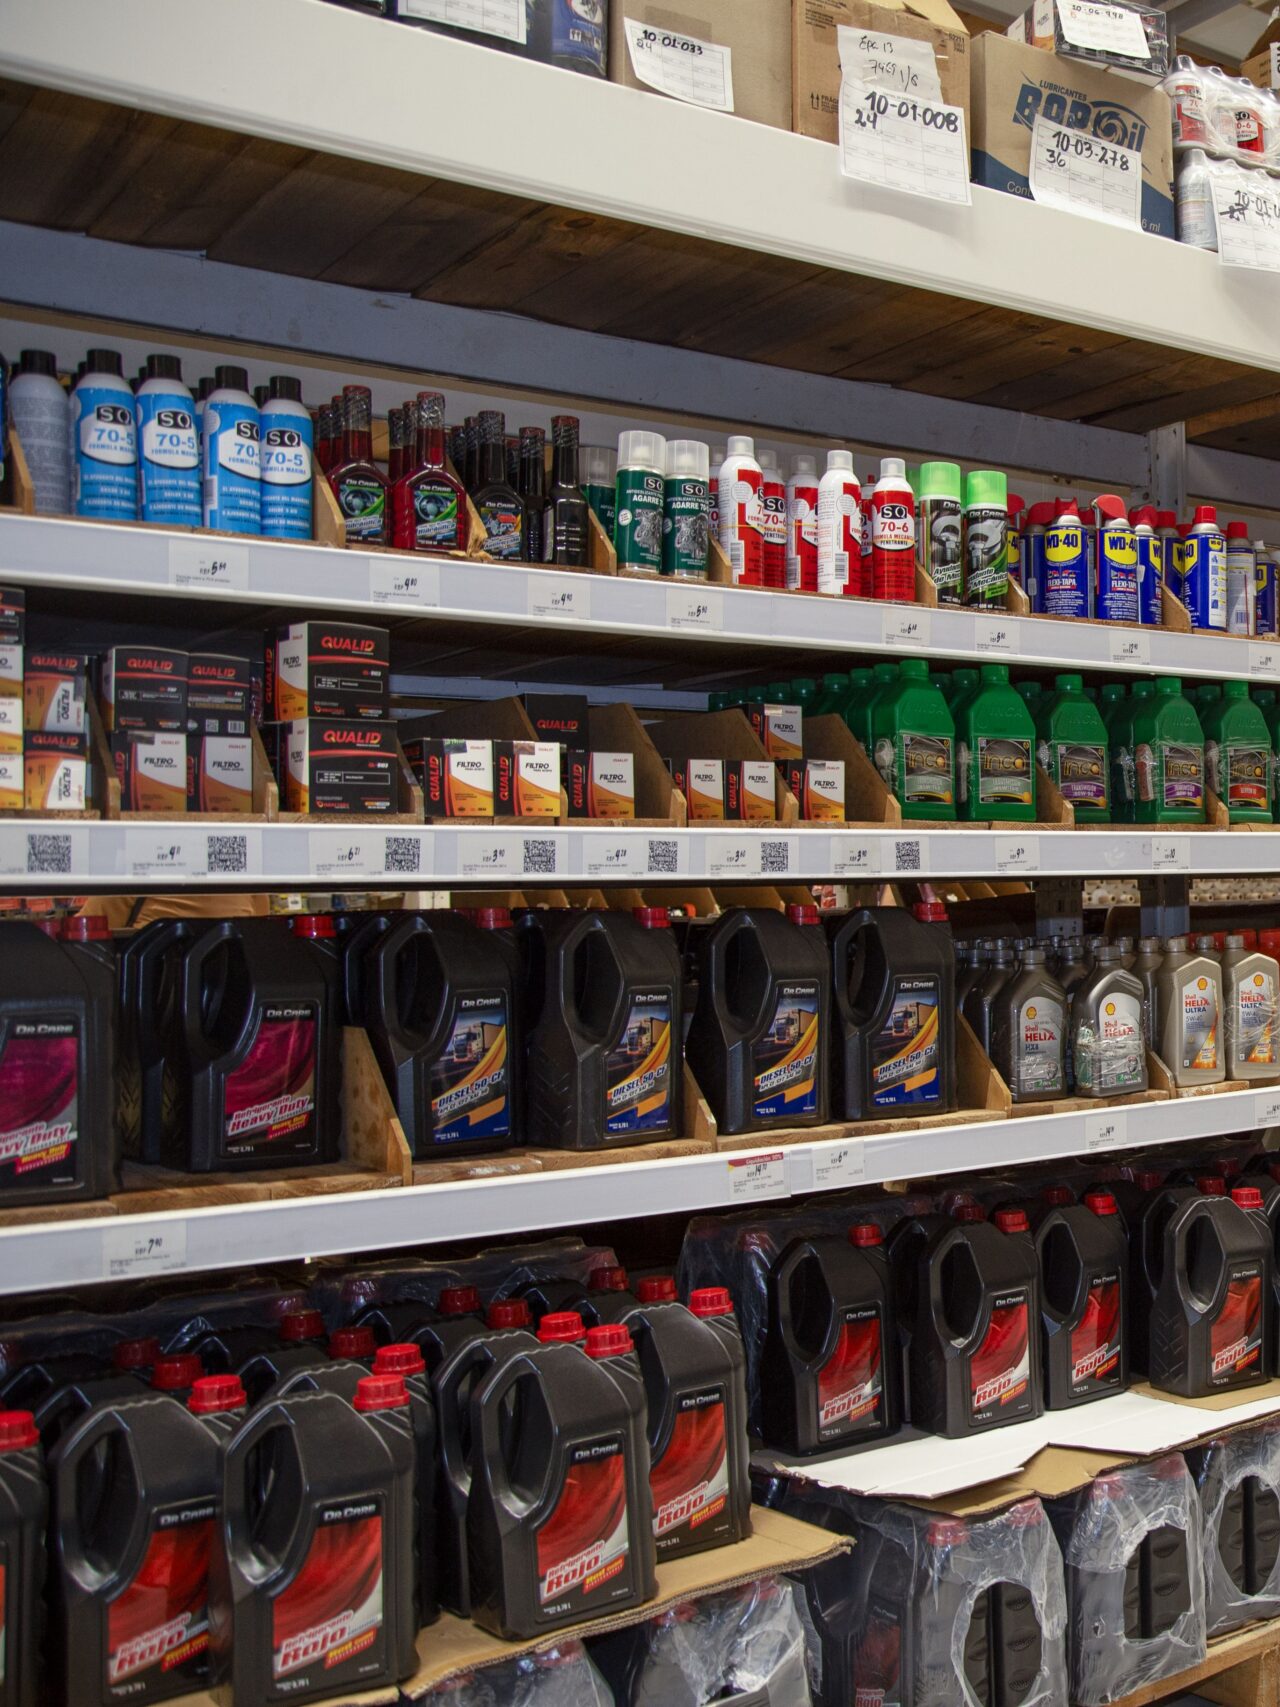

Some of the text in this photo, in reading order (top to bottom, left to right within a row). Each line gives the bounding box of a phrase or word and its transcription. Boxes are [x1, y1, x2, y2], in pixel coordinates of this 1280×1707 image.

[1039, 79, 1088, 102] LUBRICANTES
[855, 108, 878, 130] 24
[864, 91, 959, 134] 10-01-008
[1052, 130, 1129, 171] 10-03-278
[99, 406, 131, 425] SQ
[160, 411, 192, 429] SQ
[94, 428, 134, 446] 70-5
[156, 433, 196, 450] 70-5
[269, 431, 299, 448] SQ
[264, 452, 304, 467] 70-5
[684, 485, 705, 497] SQ
[671, 501, 700, 511] AGARRE
[881, 504, 907, 519] SQ
[880, 521, 909, 533] 70-6
[1046, 533, 1079, 550] WD-40
[320, 635, 376, 653] QUALID
[32, 655, 78, 670] QUALID
[127, 658, 174, 671] QUALID
[192, 665, 236, 678] QUALID
[61, 688, 70, 721] FILTRO
[536, 719, 579, 731] QUALID
[32, 736, 79, 748] QUALID
[322, 729, 382, 745] QUALID
[144, 757, 174, 766] FILTRO
[212, 760, 241, 769] FILTRO
[456, 761, 482, 769] FILTRO
[525, 762, 550, 770] FILTRO
[908, 752, 947, 769] inca
[984, 752, 1026, 771] inca
[1063, 760, 1102, 776] inca
[1167, 760, 1199, 777] inca
[430, 755, 440, 802] QUALID
[500, 757, 509, 802] QUALID
[600, 773, 624, 782] FILTRO
[1232, 762, 1264, 779] inca
[62, 766, 72, 798] FILTRO
[573, 763, 583, 809] QUALID
[814, 780, 836, 788] FILTRO
[1185, 998, 1210, 1007] HELIX
[1024, 1032, 1057, 1042] HELIX
[760, 1066, 788, 1084] DIESEL
[879, 1057, 906, 1075] DIESEL
[438, 1086, 470, 1108] DIESEL
[612, 1081, 640, 1098] DIESEL
[230, 1098, 309, 1134] Heavy Duty
[30, 1124, 70, 1146] Duty
[1074, 1352, 1106, 1378] Rojo
[1214, 1346, 1246, 1371] Rojo
[975, 1376, 1011, 1404] Rojo
[823, 1391, 862, 1422] Rojo
[659, 1482, 708, 1515] Refrigerante
[658, 1493, 704, 1530] Rojo
[548, 1541, 604, 1577] Refrigerante
[546, 1553, 600, 1595] Rojo
[283, 1611, 353, 1648] Refrigerante
[115, 1627, 185, 1677] Rojo
[279, 1626, 347, 1669] Rojo
